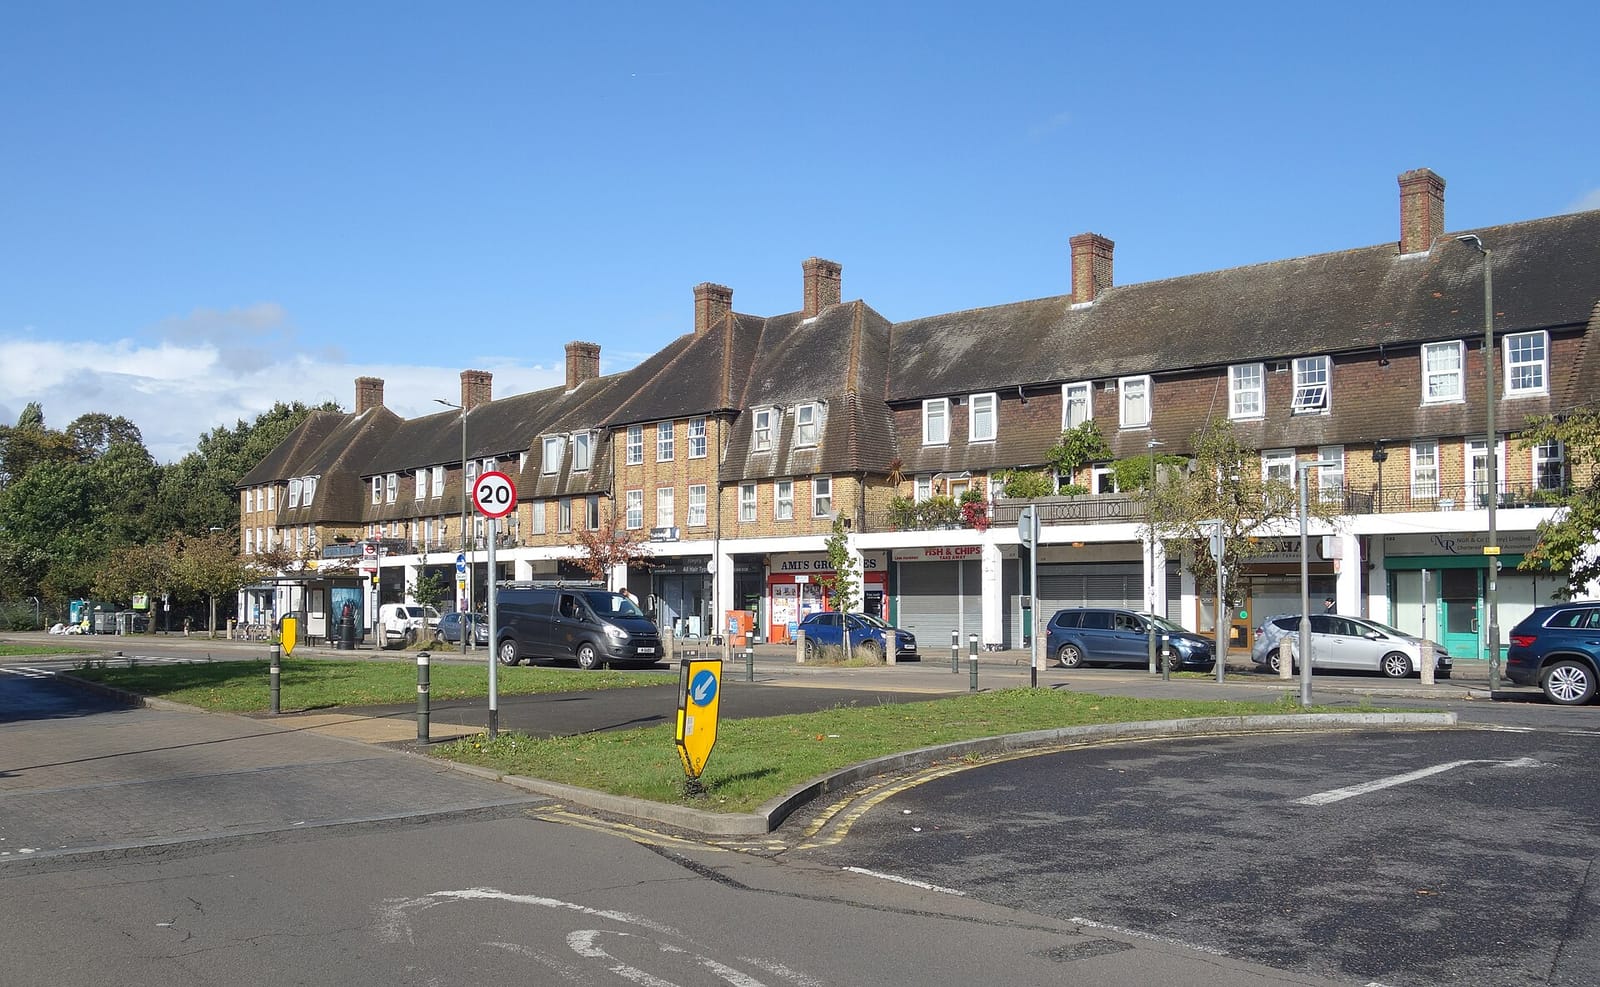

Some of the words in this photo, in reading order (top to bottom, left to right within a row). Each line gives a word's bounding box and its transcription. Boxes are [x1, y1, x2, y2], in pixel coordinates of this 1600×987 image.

[480, 485, 510, 504] 20
[945, 548, 953, 556] &
[955, 546, 981, 555] CHIPS
